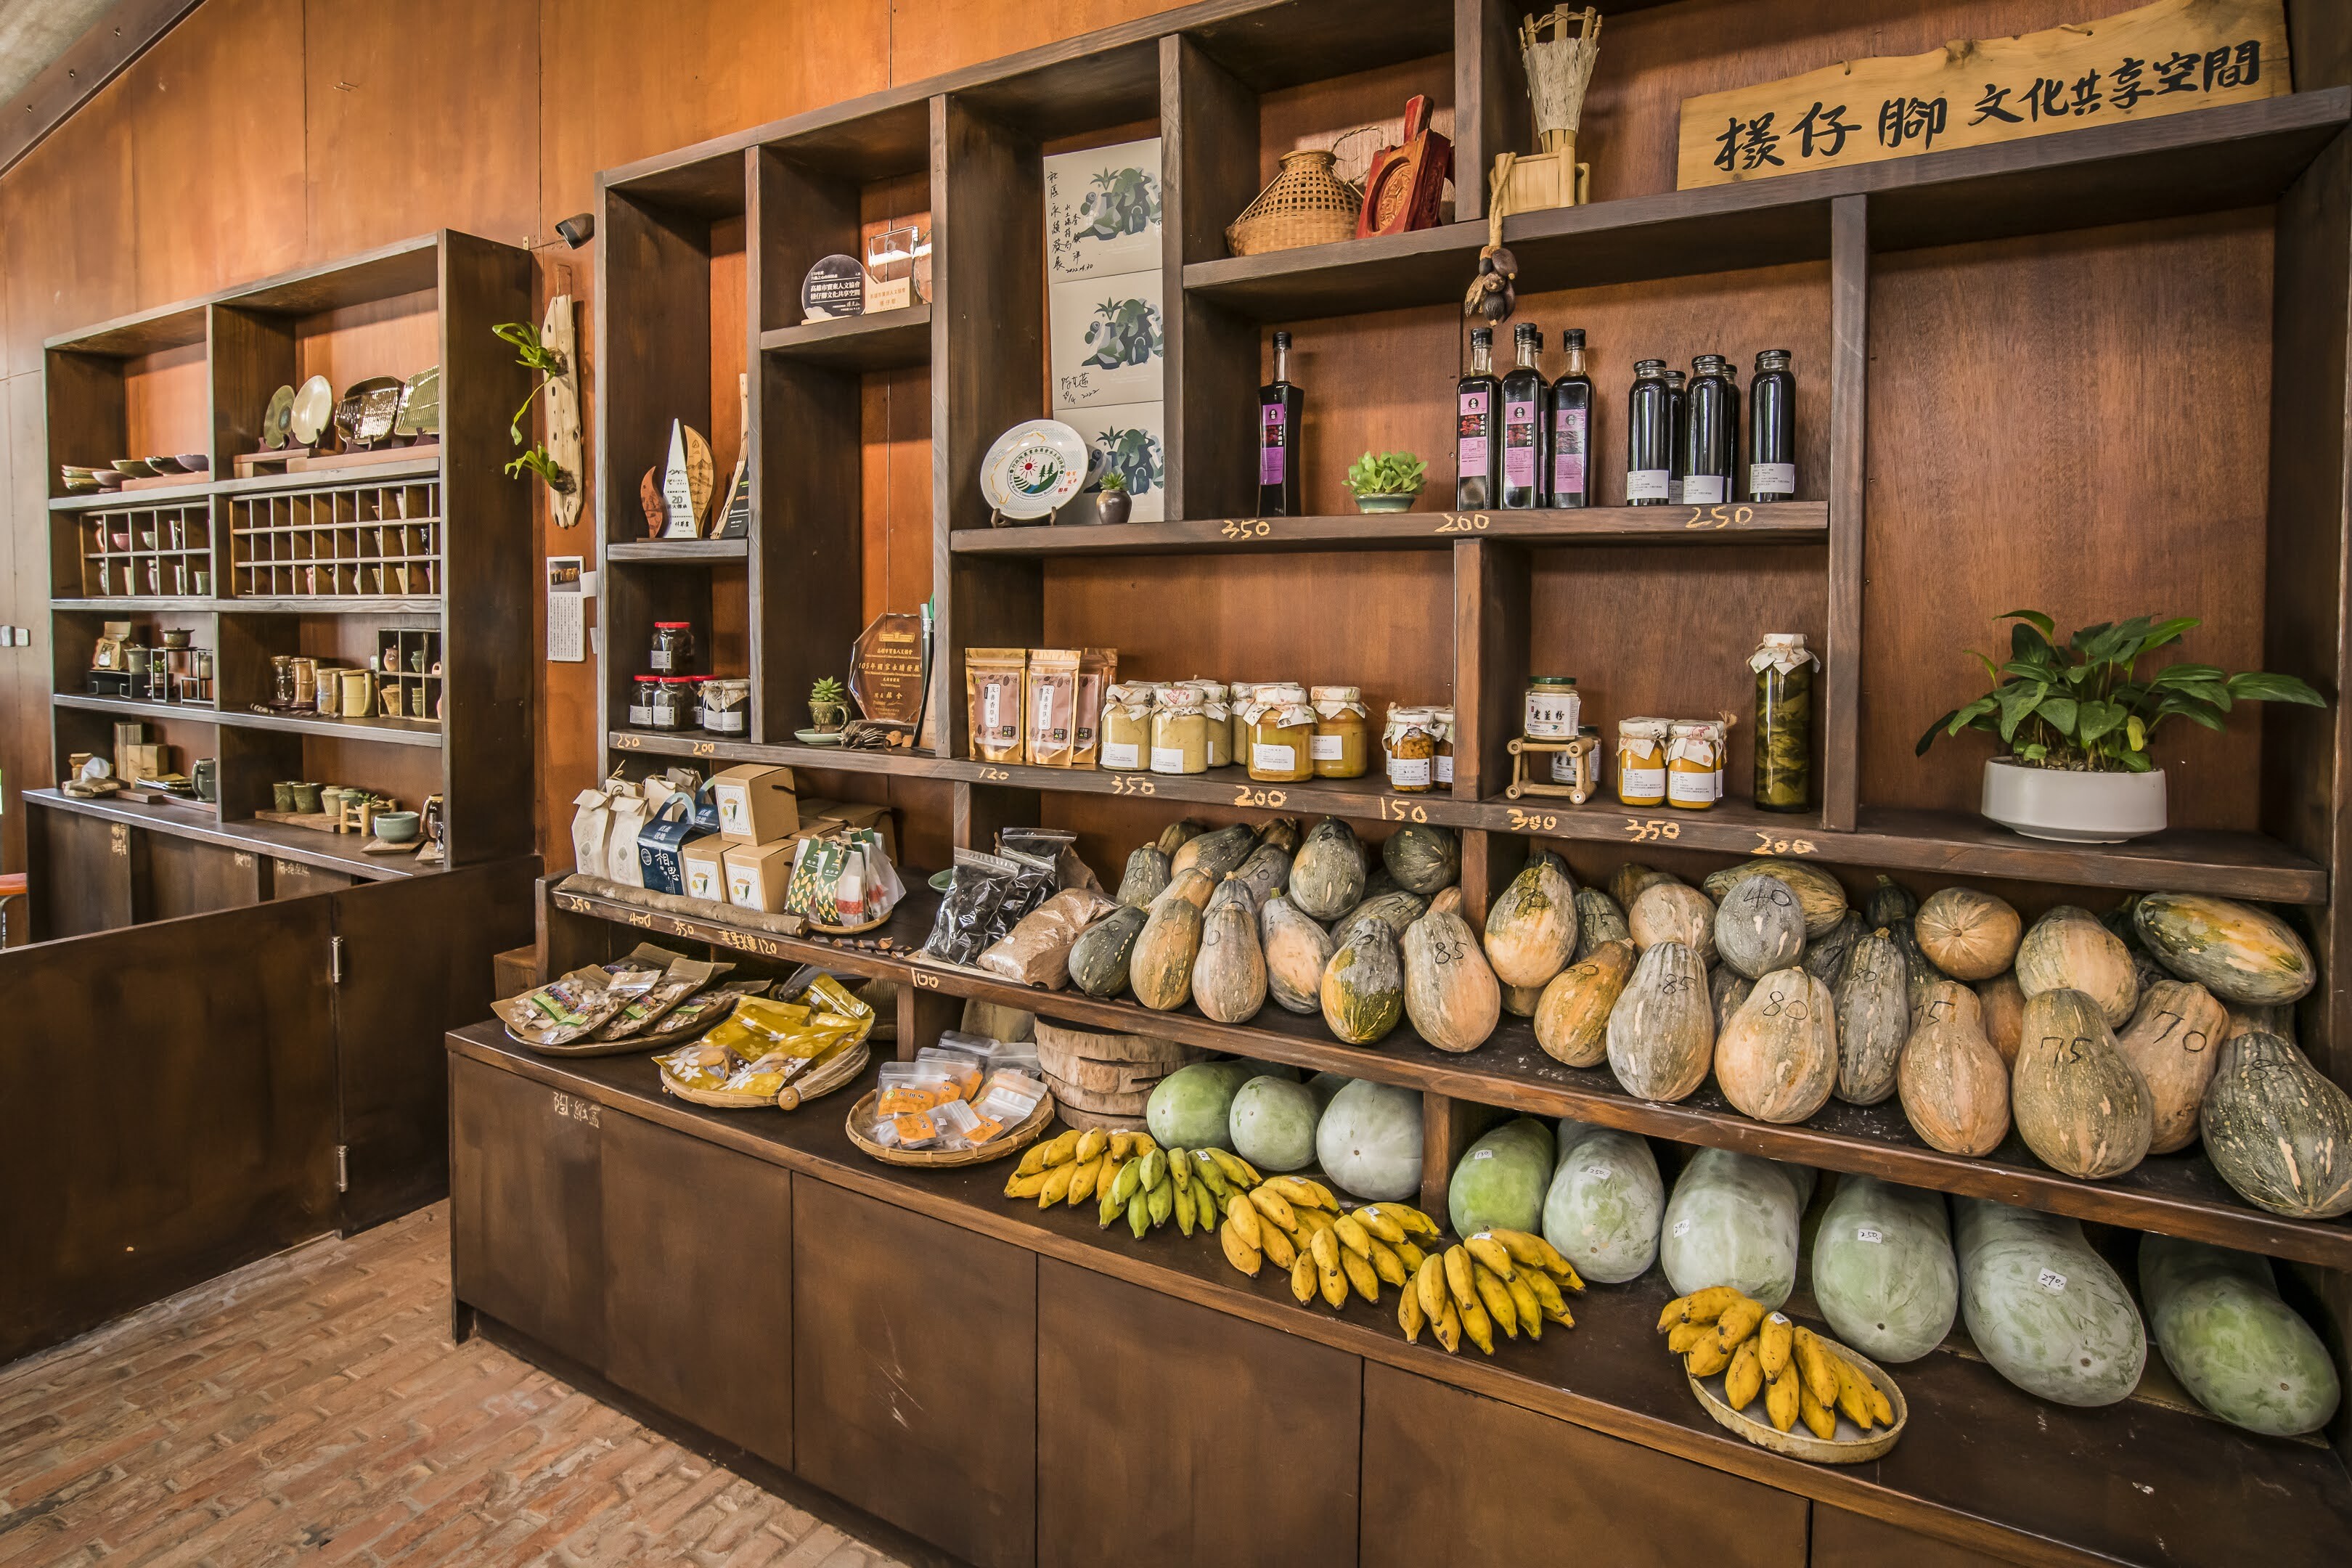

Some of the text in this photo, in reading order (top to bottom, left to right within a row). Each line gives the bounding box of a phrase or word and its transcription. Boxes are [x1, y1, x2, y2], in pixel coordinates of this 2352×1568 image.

[1967, 39, 2261, 126] 文化共享空間
[1434, 513, 1490, 534] 200
[1685, 505, 1754, 528] 250
[1221, 520, 1270, 539] 350
[693, 741, 715, 756] 200
[979, 767, 1010, 780] 120
[1111, 775, 1156, 796] 350
[1234, 785, 1288, 808] 200
[1380, 796, 1429, 824] 150
[1624, 818, 1681, 843] 350
[1744, 884, 1792, 909] 40
[628, 912, 652, 928] 400
[674, 920, 695, 936] 350
[758, 937, 777, 955] 120
[1434, 941, 1467, 965] 85
[910, 967, 939, 988] 100
[1662, 973, 1696, 995] 85
[1763, 991, 1808, 1021] 80
[2150, 1010, 2206, 1053] 70
[2039, 1037, 2092, 1069] 75
